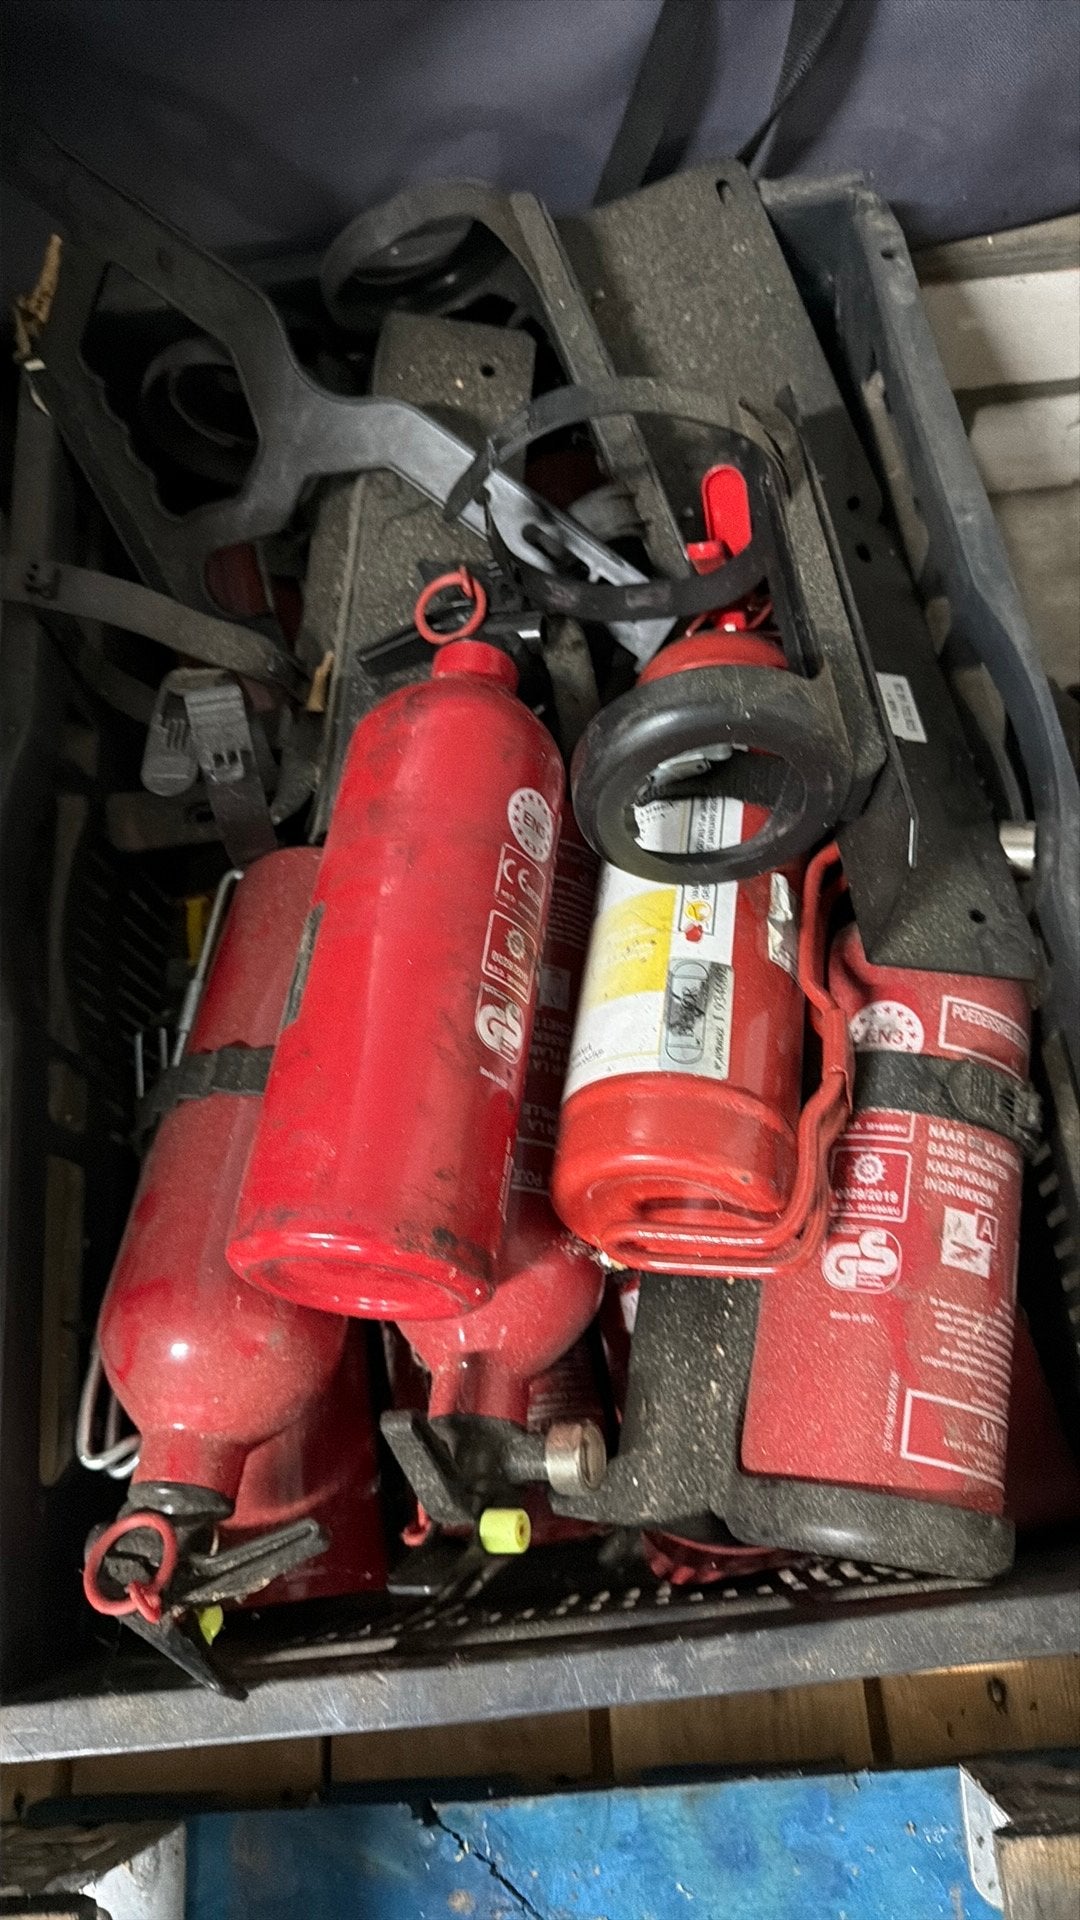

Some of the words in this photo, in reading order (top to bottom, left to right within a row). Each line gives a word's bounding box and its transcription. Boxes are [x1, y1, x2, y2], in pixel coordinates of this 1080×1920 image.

[865, 1028, 905, 1046] EN3
[928, 1123, 966, 1146] NAAR
[927, 1141, 966, 1164] BASIS
[979, 1217, 994, 1244] A
